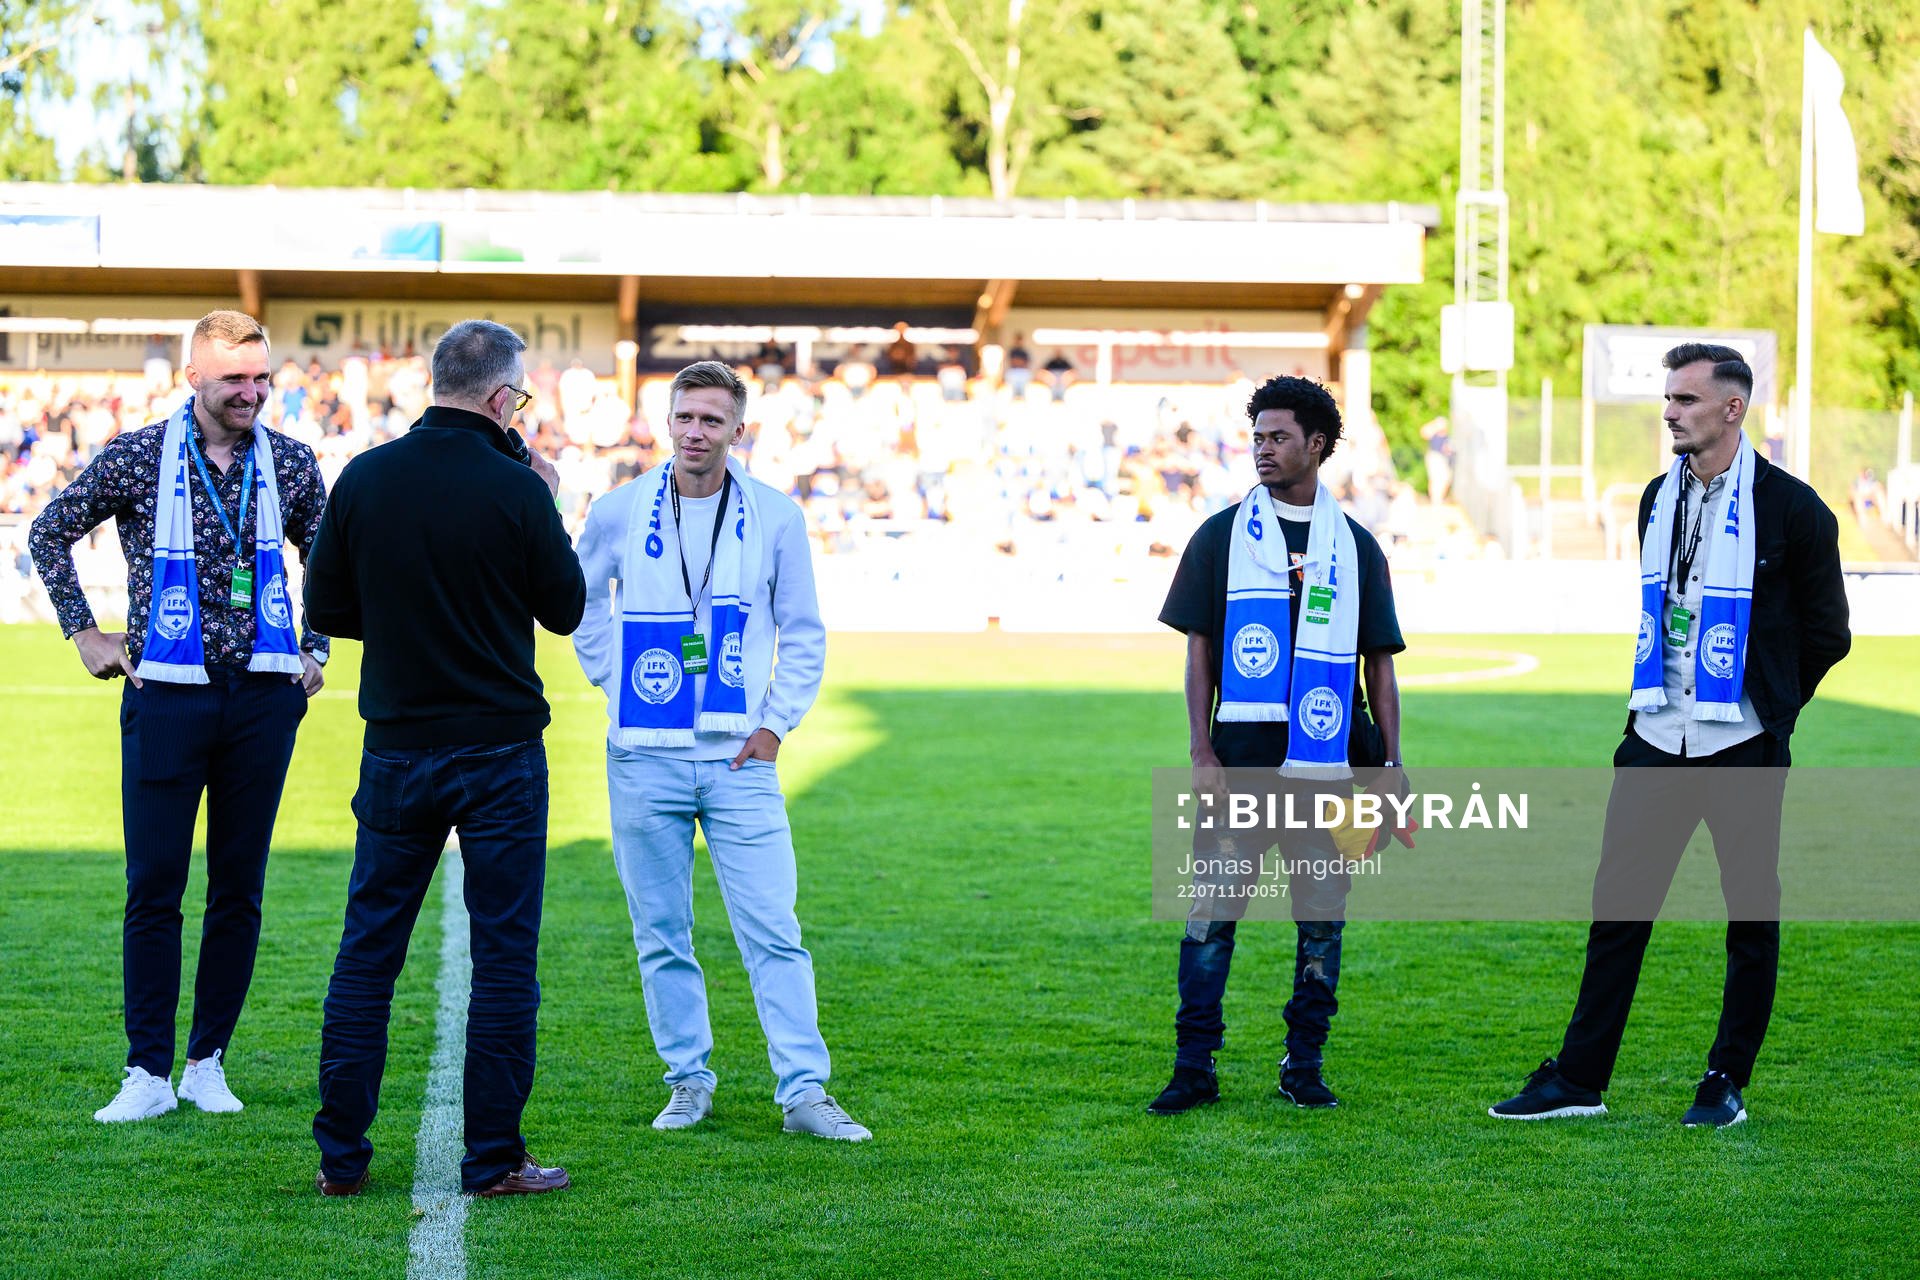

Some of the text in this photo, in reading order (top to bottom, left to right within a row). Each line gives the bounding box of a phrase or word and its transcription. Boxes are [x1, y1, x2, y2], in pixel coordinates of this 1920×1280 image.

[352, 309, 581, 352] Liljehl
[167, 599, 187, 607] IFK
[1245, 636, 1264, 645] IFK
[1716, 636, 1735, 646] IFK
[647, 661, 666, 670] IFK
[1315, 698, 1331, 709] IFK
